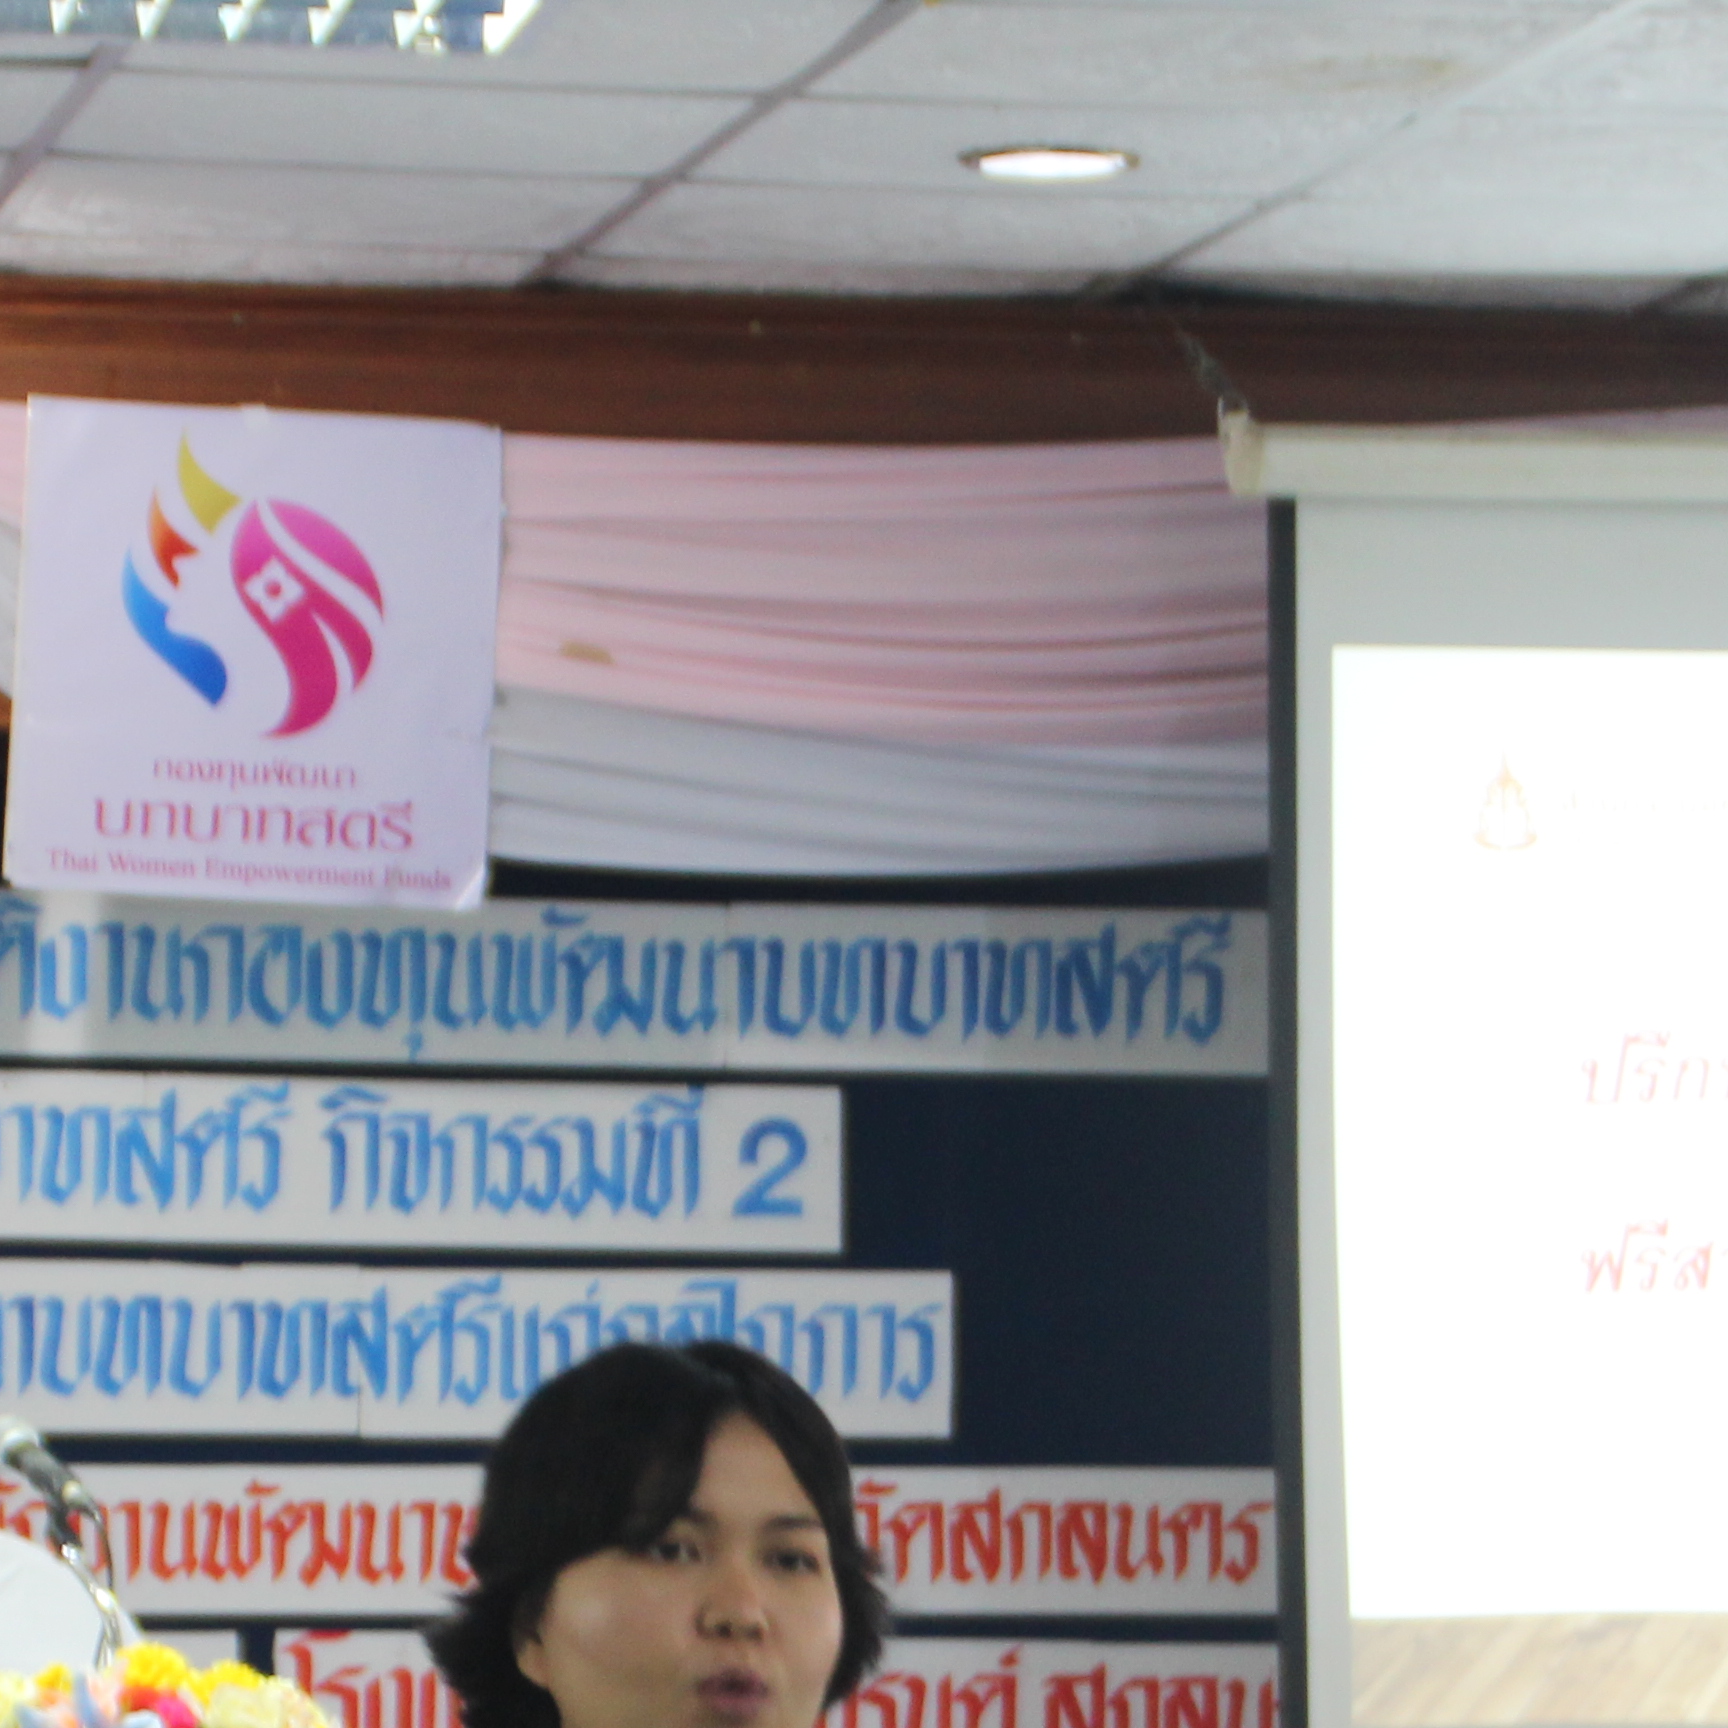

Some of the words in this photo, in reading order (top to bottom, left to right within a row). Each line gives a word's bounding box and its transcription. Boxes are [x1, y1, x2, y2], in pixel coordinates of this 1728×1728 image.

[152, 756, 358, 792] กองทุนพัฒนา
[93, 796, 414, 852] บทบาทสตรี
[46, 847, 99, 875] Thai
[108, 850, 197, 879] Women
[204, 855, 376, 888] Empowerment
[382, 864, 453, 892] Funds
[322, 1082, 705, 1216] กิจกรรมที่
[736, 1118, 809, 1216] 2
